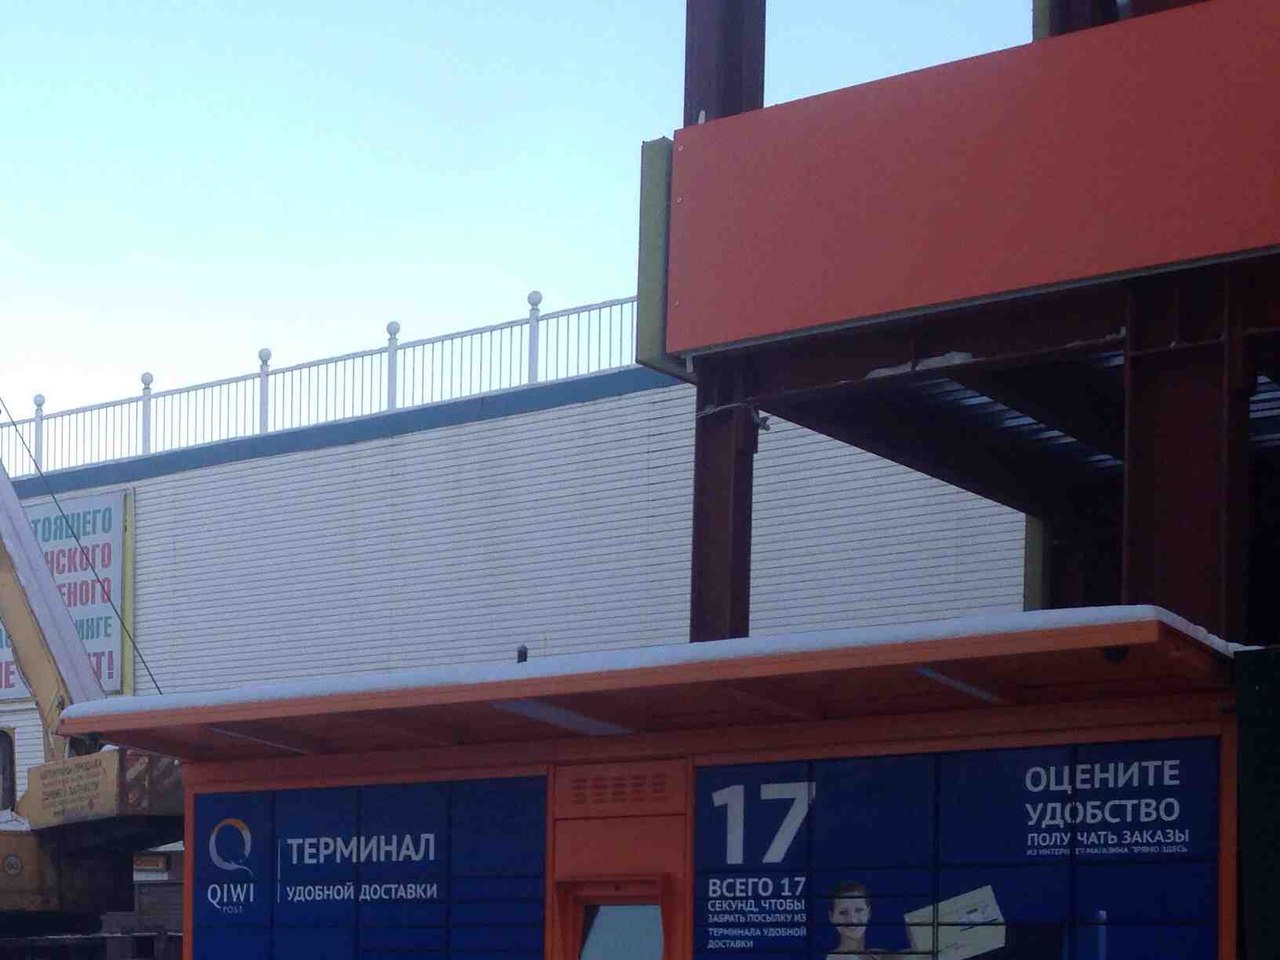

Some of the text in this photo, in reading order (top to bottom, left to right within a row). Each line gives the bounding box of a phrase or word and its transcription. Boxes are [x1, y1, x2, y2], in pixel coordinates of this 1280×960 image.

[31, 507, 112, 542] ТОЯЩЕГО
[1025, 760, 1180, 794] ОЦЕНИТЕ
[712, 782, 816, 864] 17
[1025, 798, 1180, 828] УДОБСТВО
[1121, 829, 1189, 843] ЗАКАЗЫ
[286, 833, 435, 864] ТЕРМИНАЛ
[207, 883, 254, 908] QIWI
[286, 881, 437, 902] УДОБНОЙ ДОСТАВКИ
[708, 877, 806, 897] ВСЕГО 17
[707, 899, 805, 912] СЕКУНД, ЧТОБЫ
[707, 913, 807, 923] ЗАБРАТЬ ПОСЫЛКУ ИЗ
[708, 926, 807, 937] ТЕРМИНАЛА УДОБНОЙ
[707, 939, 754, 949] ДОСТАВКИ
